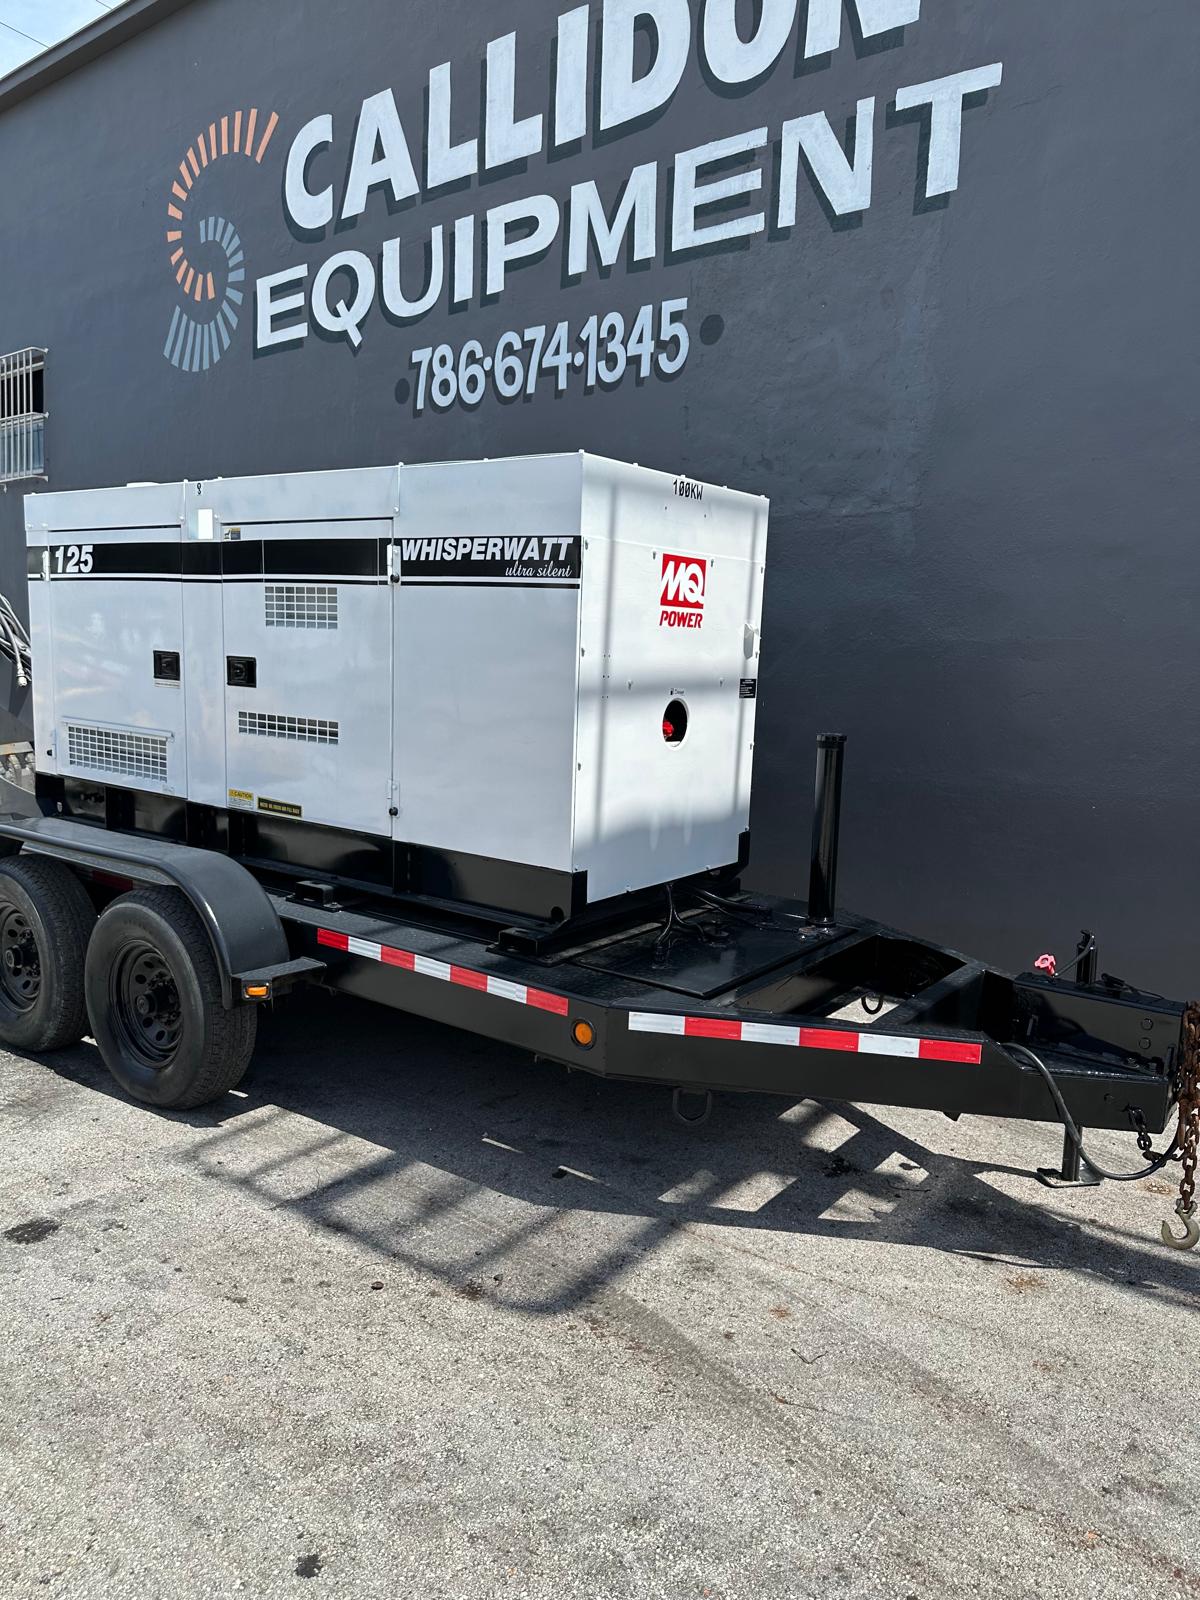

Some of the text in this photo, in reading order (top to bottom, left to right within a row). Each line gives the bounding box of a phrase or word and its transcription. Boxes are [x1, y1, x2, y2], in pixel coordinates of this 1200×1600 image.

[256, 62, 1003, 348] EQUIPMENT
[673, 479, 703, 500] 100KW
[55, 545, 94, 573] 125
[401, 537, 574, 561] WHISPERWATT
[505, 560, 572, 577] ultra silent
[660, 560, 705, 604] MQ
[659, 610, 703, 629] POWER
